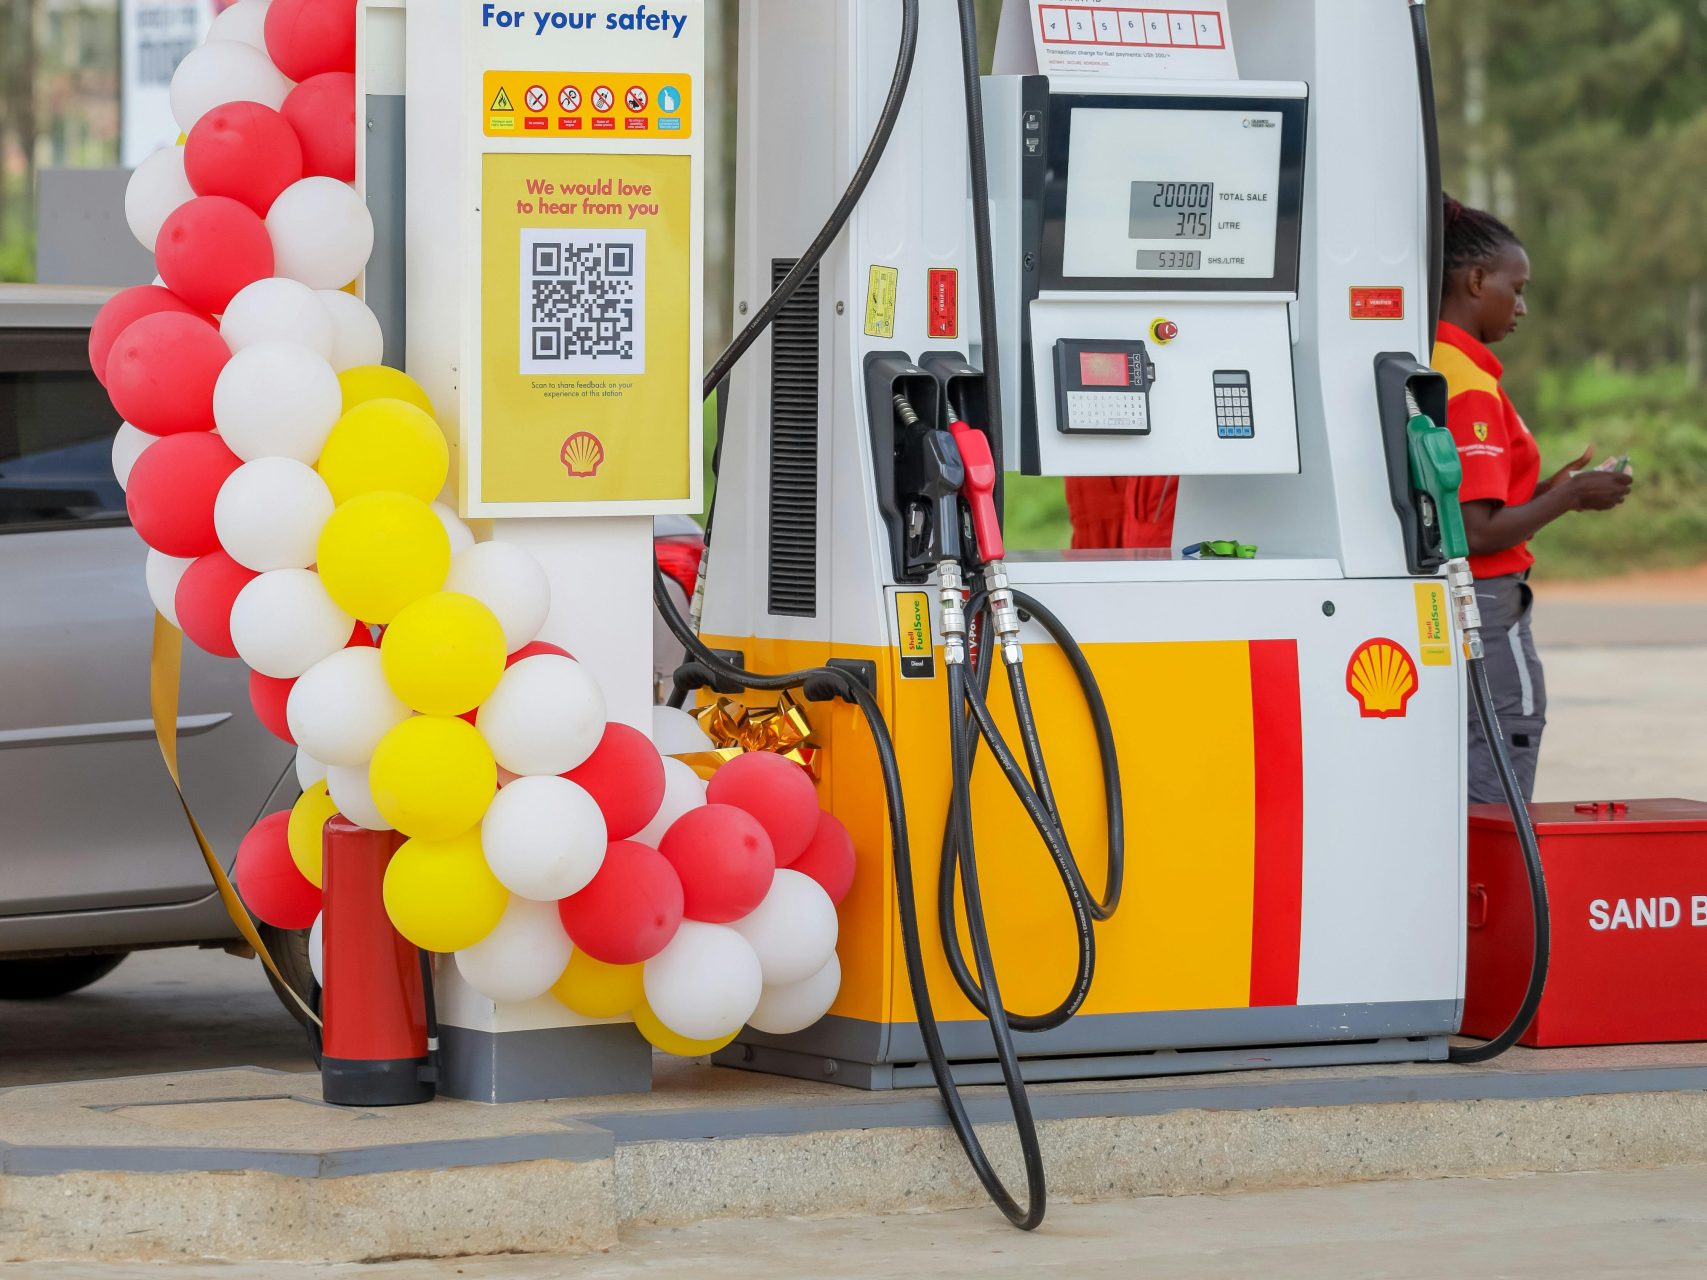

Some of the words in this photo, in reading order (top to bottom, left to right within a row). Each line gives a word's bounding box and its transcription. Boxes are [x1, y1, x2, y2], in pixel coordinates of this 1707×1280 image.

[483, 4, 524, 27] For
[534, 12, 596, 35] your
[606, 5, 687, 38] safety
[526, 179, 554, 194] We
[560, 178, 612, 195] would
[618, 179, 651, 195] love
[1153, 184, 1209, 207] 20000
[1219, 193, 1244, 201] TOTAL
[517, 200, 533, 214] to
[539, 197, 577, 214] hear
[582, 198, 622, 214] from
[628, 204, 658, 220] you
[1160, 252, 1193, 268] 5330
[544, 391, 579, 399] experience
[914, 600, 923, 650] FuelSave
[1432, 592, 1440, 639] FuelSave
[1589, 896, 1681, 931] SAND
